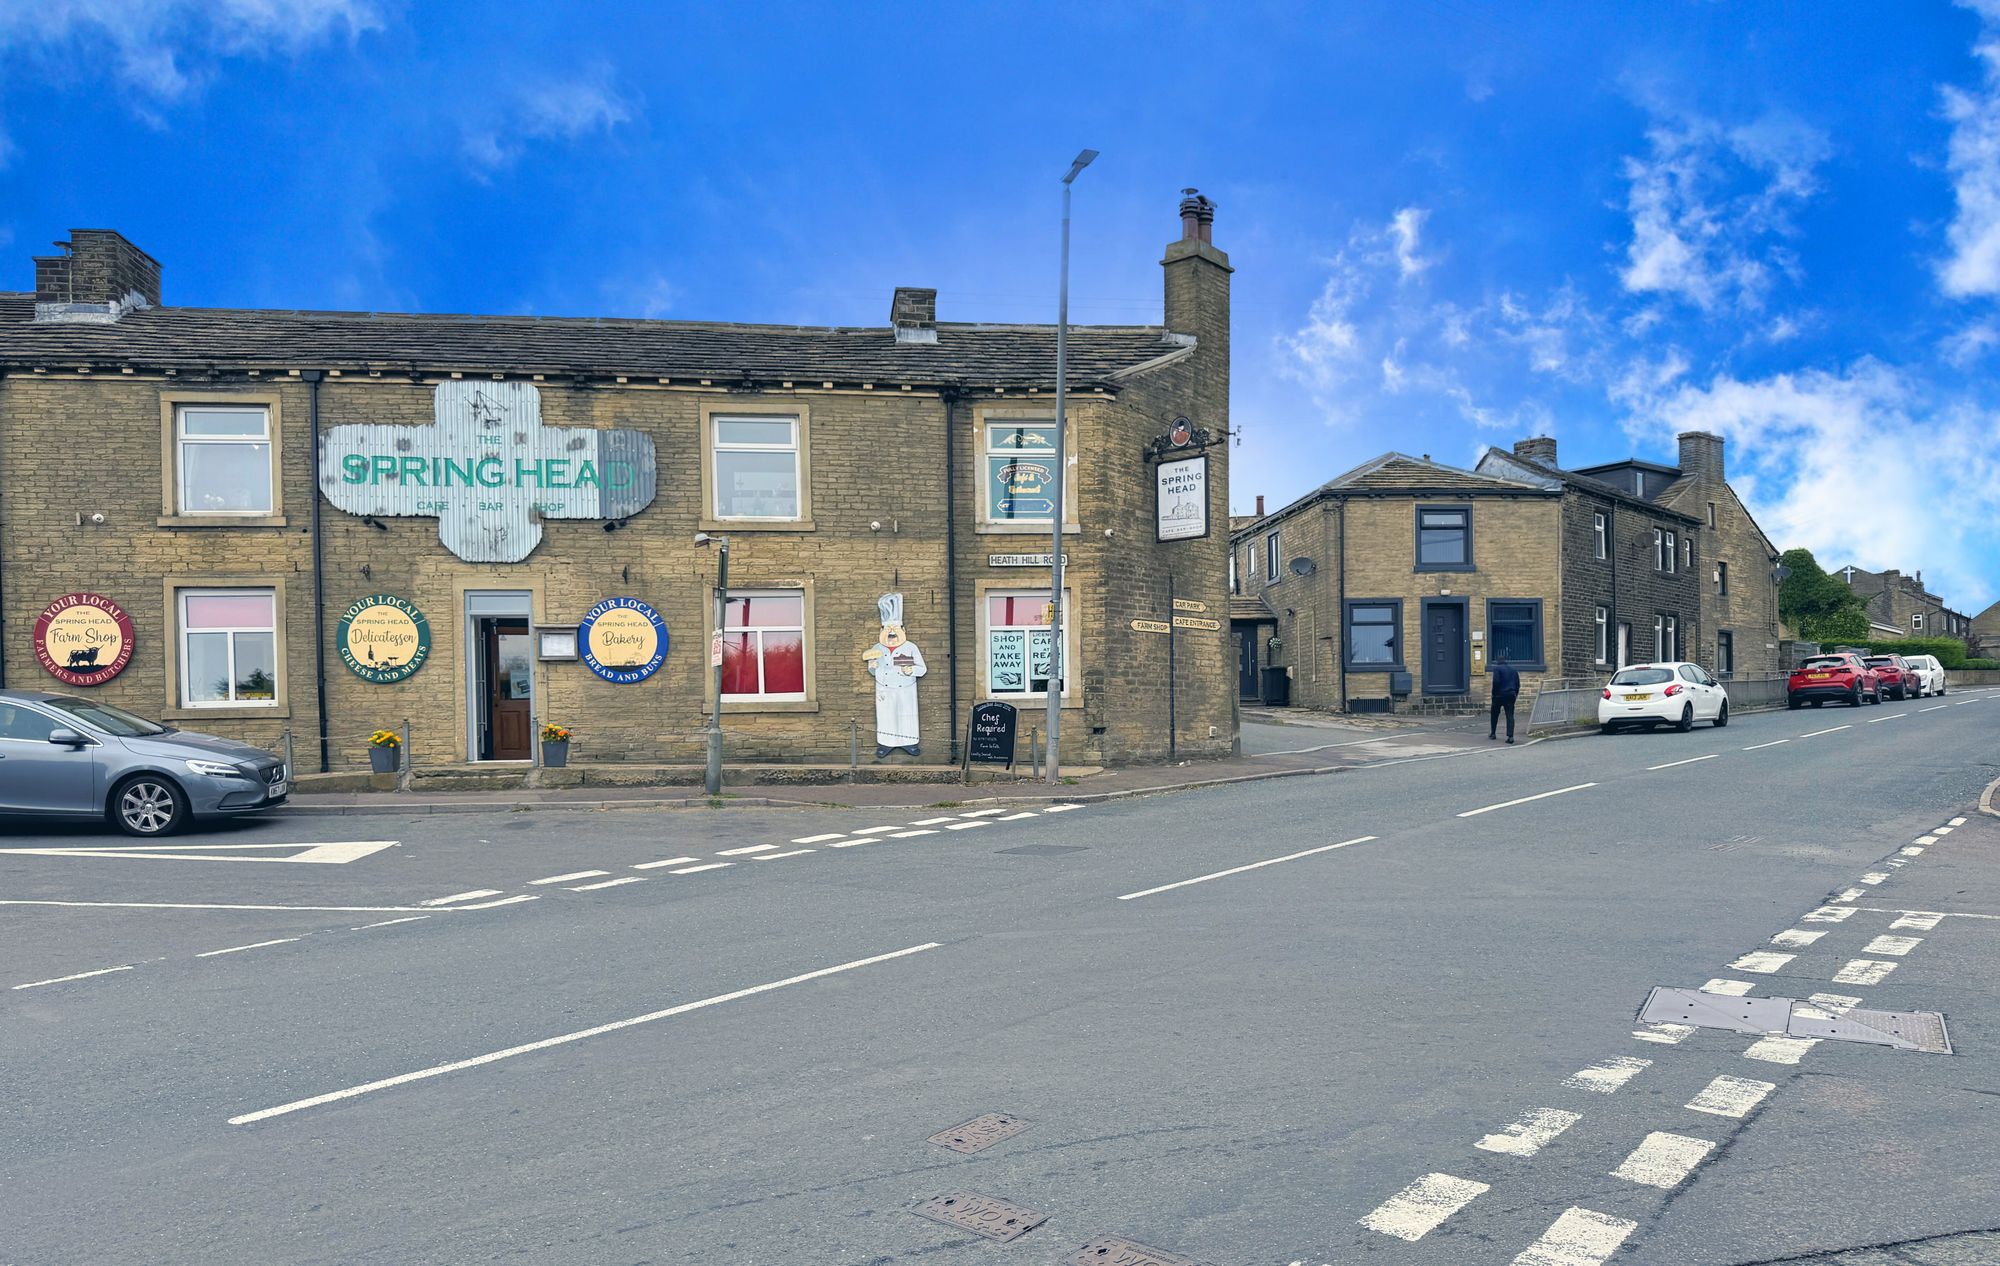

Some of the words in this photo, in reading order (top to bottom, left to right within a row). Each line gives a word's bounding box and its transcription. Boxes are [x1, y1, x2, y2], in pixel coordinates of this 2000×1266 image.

[476, 435, 502, 446] THE
[341, 454, 506, 489] SPRING
[514, 458, 635, 490] HEAD
[1161, 473, 1202, 486] SPRING
[1167, 483, 1196, 495] HEAD
[416, 501, 449, 511] CAFE
[479, 502, 504, 512] BAR
[533, 502, 565, 512] SHOP
[990, 556, 1018, 564] HEATH
[1022, 556, 1039, 564] HILL
[1044, 556, 1066, 564] ROD
[43, 595, 78, 619] YOUR
[82, 594, 122, 620] LOCAL
[343, 597, 375, 620] YOUR
[378, 595, 418, 620] LOCAL
[585, 599, 617, 621] YOUR
[620, 598, 659, 623] LOCAL
[1137, 622, 1153, 630] FARM
[1153, 623, 1168, 631] SHOP
[1189, 619, 1216, 629] ENTRANCE
[50, 627, 82, 644] Farm
[85, 627, 118, 646] Shop
[351, 628, 416, 646] Delicatessen
[602, 630, 645, 650] Bakery
[36, 639, 68, 680] FARMERS
[70, 675, 93, 683] AND
[95, 638, 132, 681] BUTCHERS
[341, 647, 373, 679] CHEESE
[377, 672, 399, 680] AND
[402, 645, 426, 675] MEATS
[585, 653, 614, 679] BREAD
[617, 673, 639, 681] AND
[641, 654, 663, 677] BUNS
[981, 713, 1000, 725] Chef
[976, 723, 1006, 736] Required
